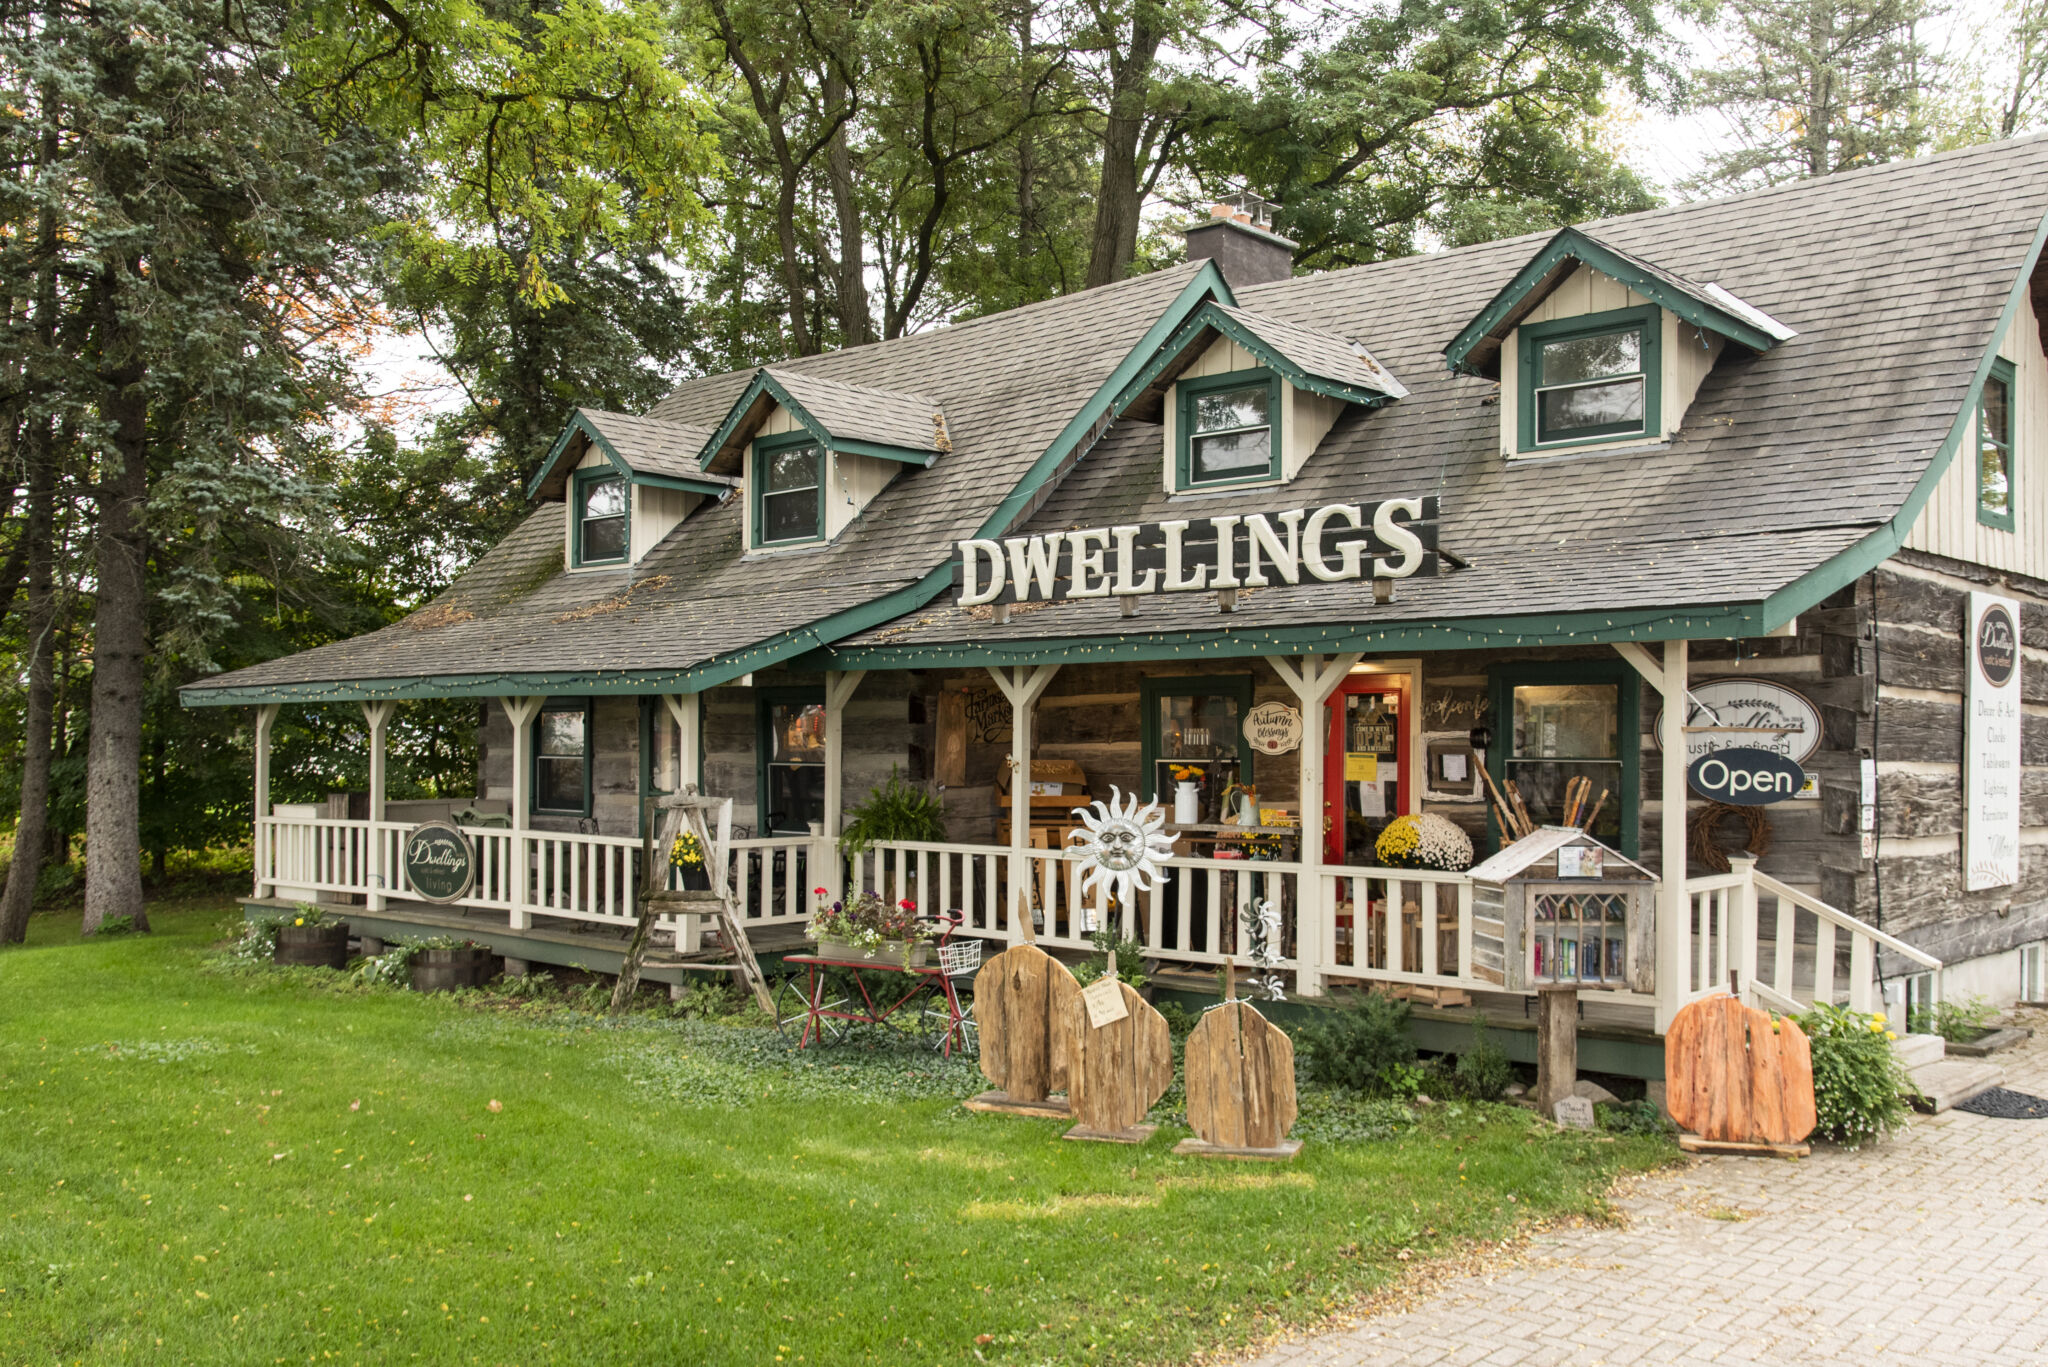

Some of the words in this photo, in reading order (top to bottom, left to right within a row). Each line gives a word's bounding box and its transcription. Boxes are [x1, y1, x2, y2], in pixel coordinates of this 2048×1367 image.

[957, 497, 1424, 606] DWELLINGS
[1253, 710, 1293, 727] Autumn
[1698, 759, 1793, 797] Open
[409, 839, 466, 873] Dwellings
[425, 878, 452, 893] living
